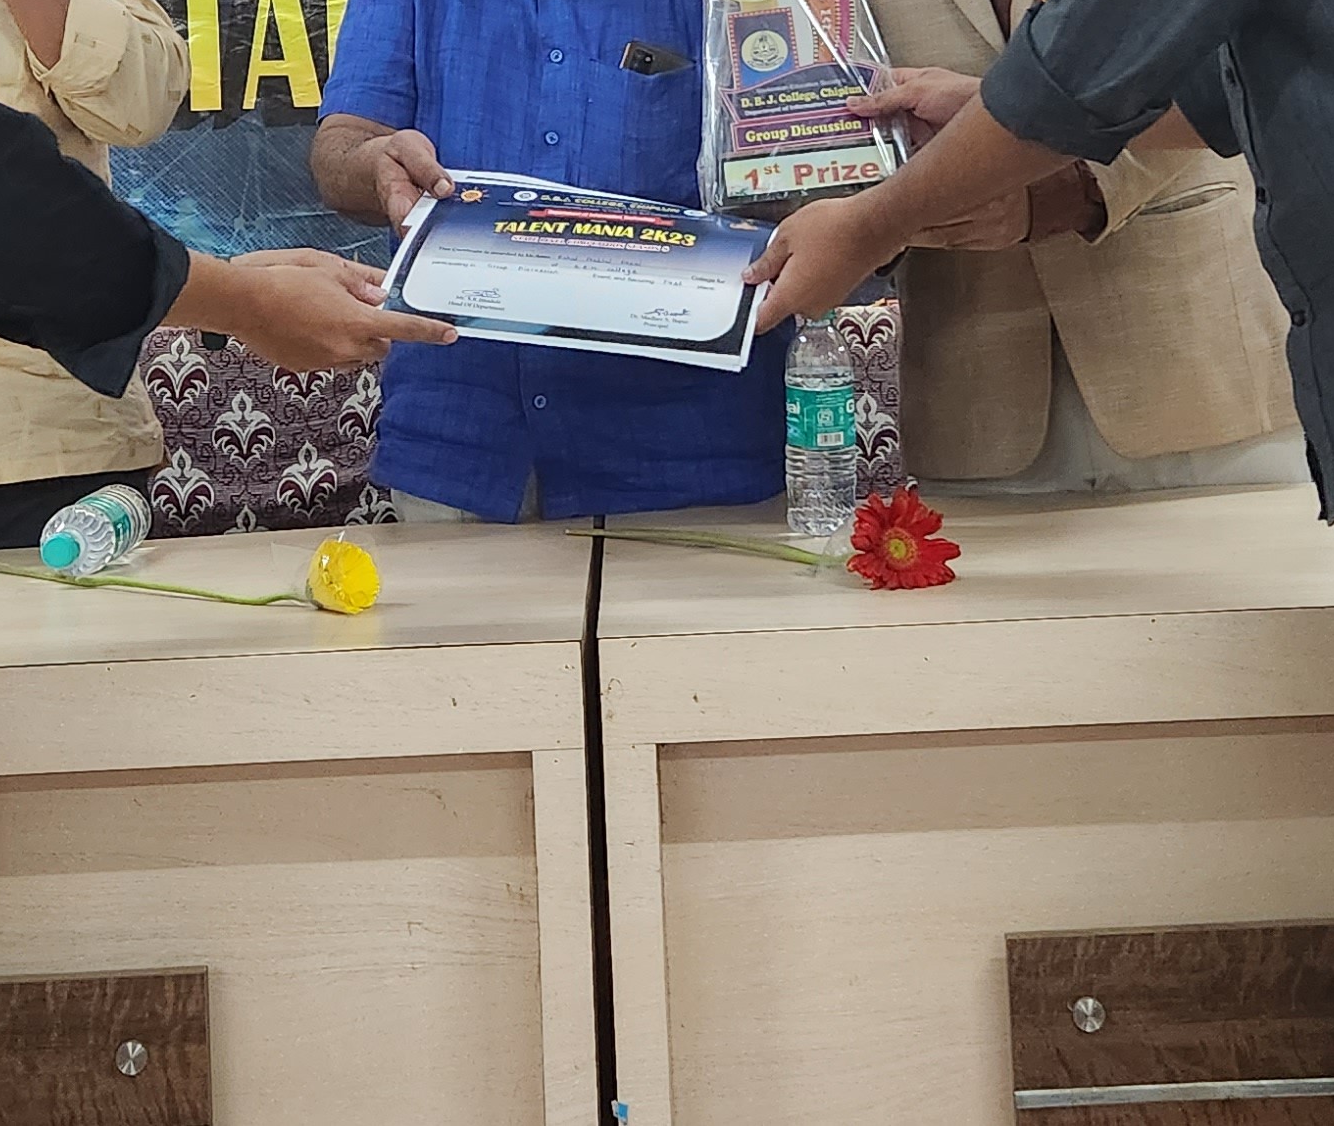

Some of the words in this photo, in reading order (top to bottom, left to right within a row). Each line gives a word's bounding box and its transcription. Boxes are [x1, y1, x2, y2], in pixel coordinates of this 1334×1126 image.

[745, 129, 788, 143] Group
[791, 119, 862, 137] Discussion
[744, 163, 781, 191] 1st
[793, 160, 880, 186] Prize
[493, 220, 569, 235] TALENT
[573, 222, 635, 239] MANIA
[640, 228, 697, 247] 2K23
